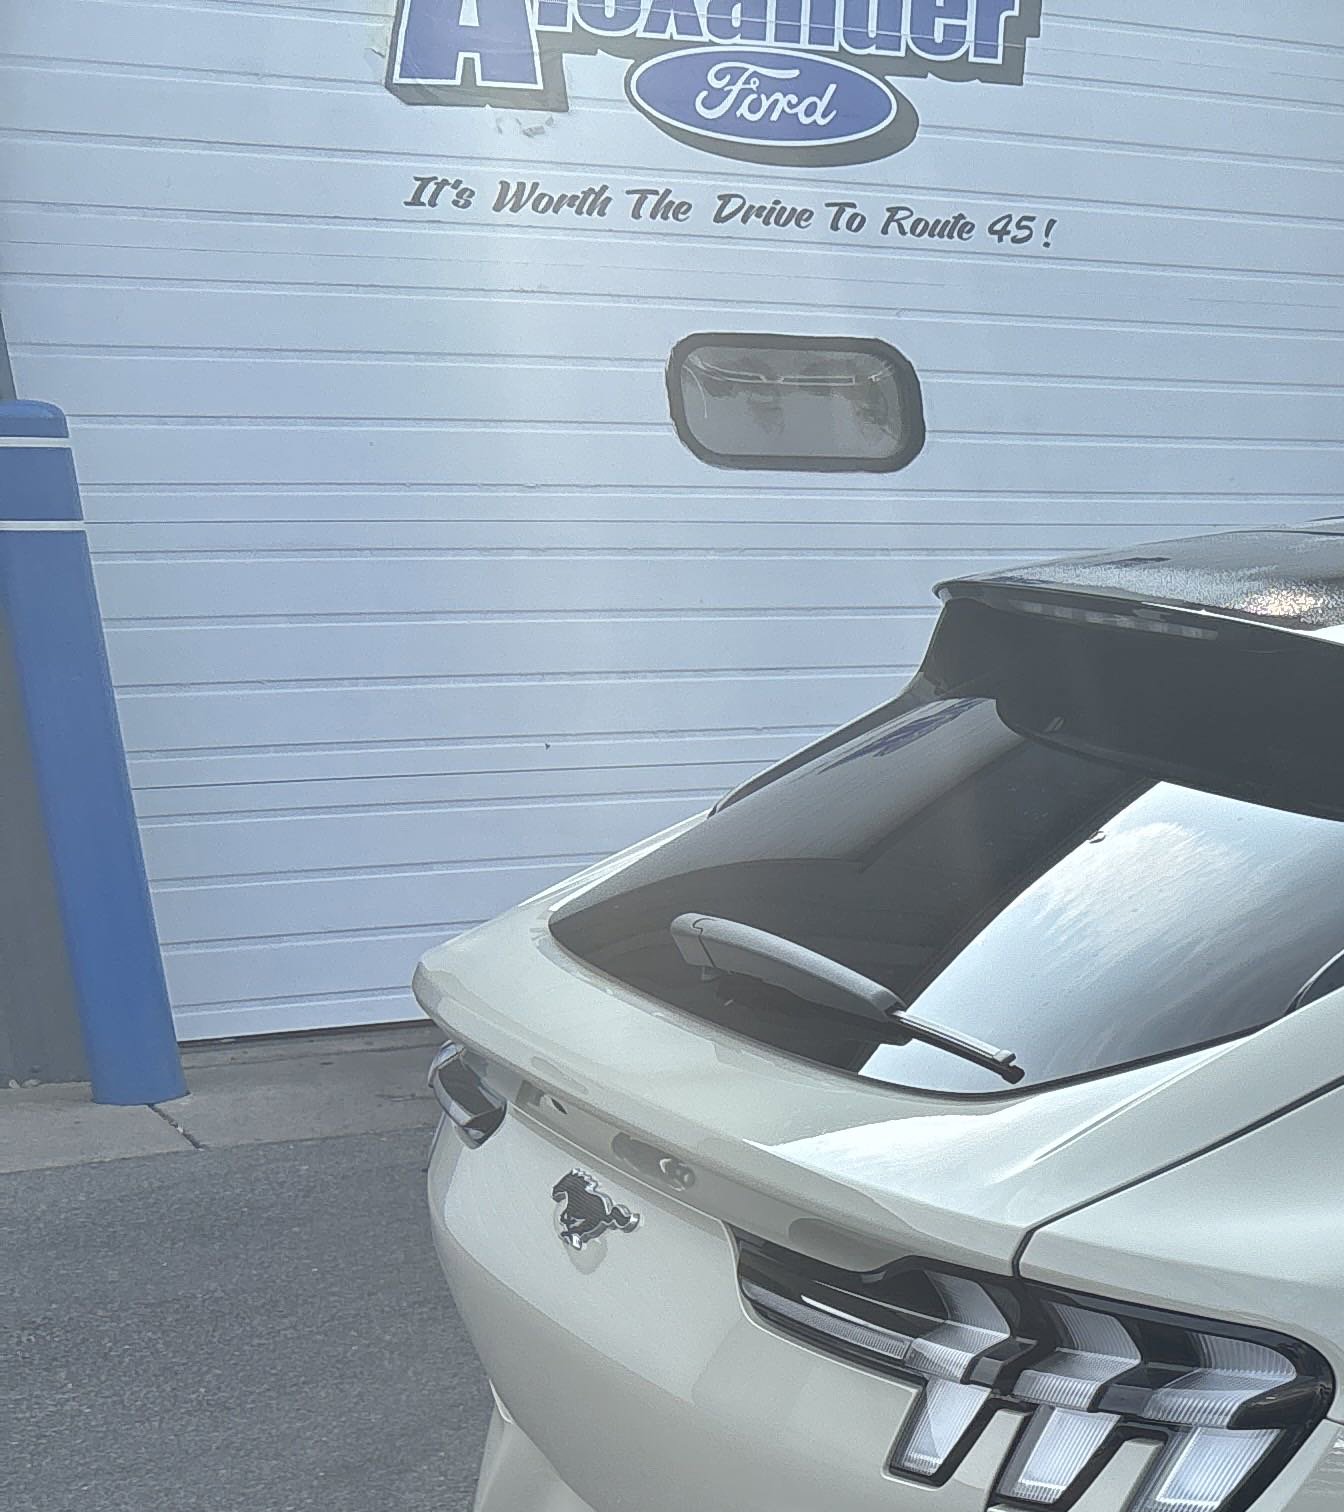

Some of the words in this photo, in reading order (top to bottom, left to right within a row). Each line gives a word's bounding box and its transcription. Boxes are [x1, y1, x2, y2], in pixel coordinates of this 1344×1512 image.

[694, 61, 838, 127] Ford
[403, 176, 476, 210] It's
[492, 180, 613, 218] Worth
[626, 188, 693, 223] The
[712, 193, 815, 229] Drive
[825, 201, 867, 232] To
[881, 206, 976, 242] Route
